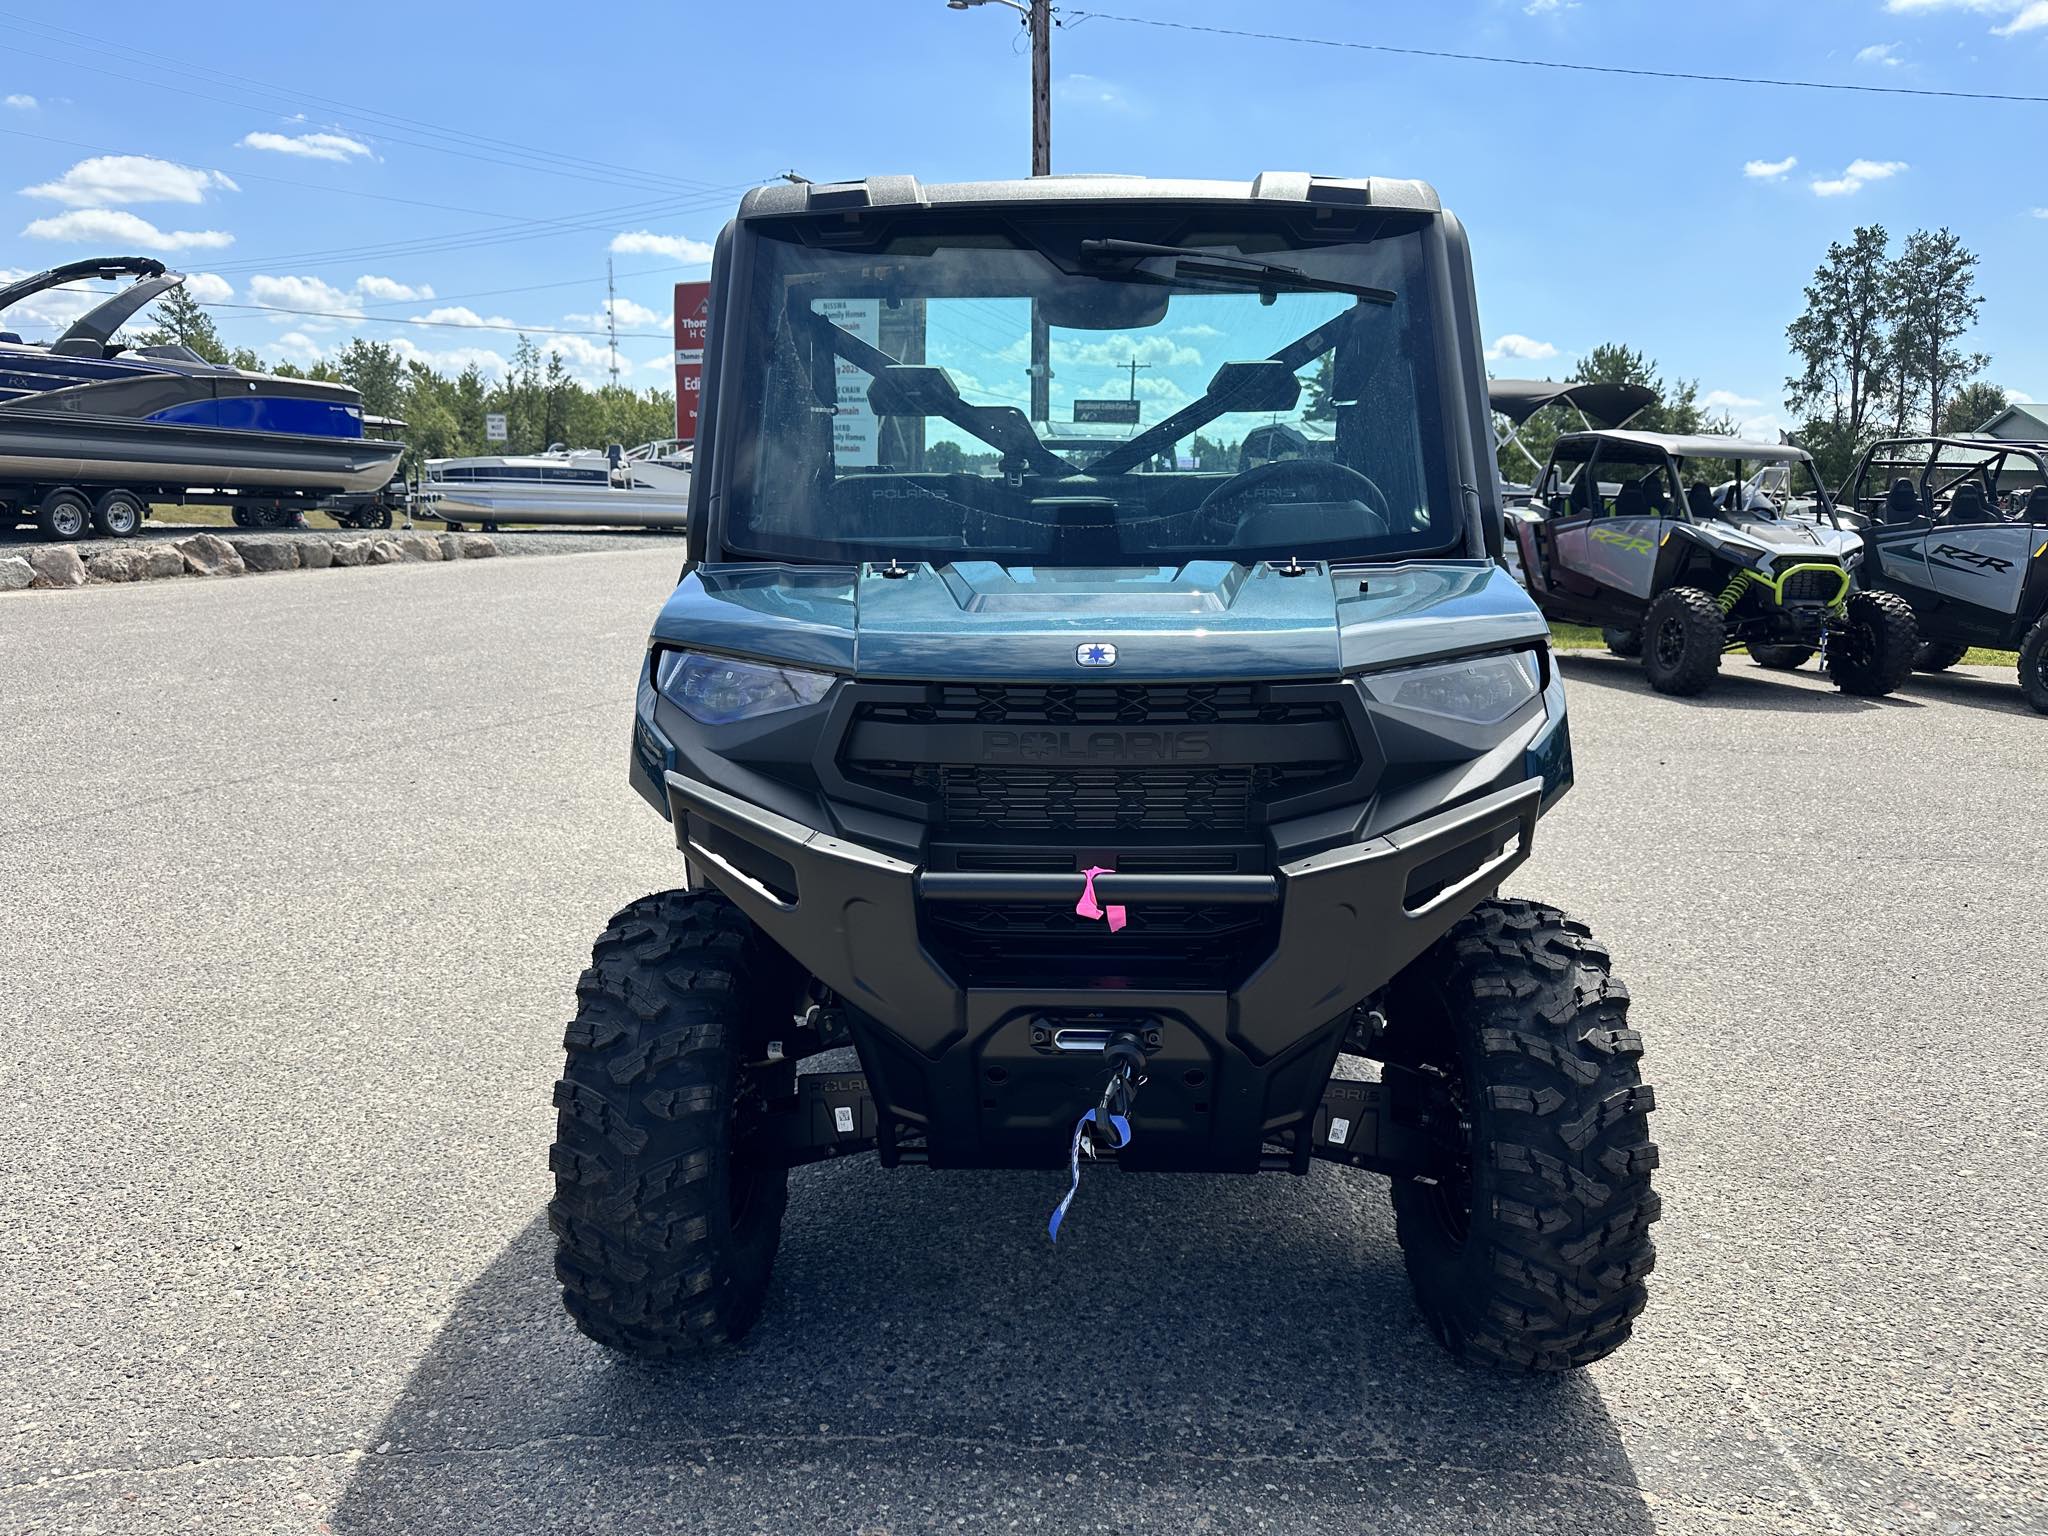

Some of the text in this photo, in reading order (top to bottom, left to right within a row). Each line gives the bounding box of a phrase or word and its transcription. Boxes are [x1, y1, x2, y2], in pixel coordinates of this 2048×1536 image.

[845, 310, 866, 318] Homes
[838, 406, 859, 415] emain
[1590, 527, 1655, 556] RZR
[1930, 543, 2015, 575] RZR
[982, 730, 1212, 762] POLARIS
